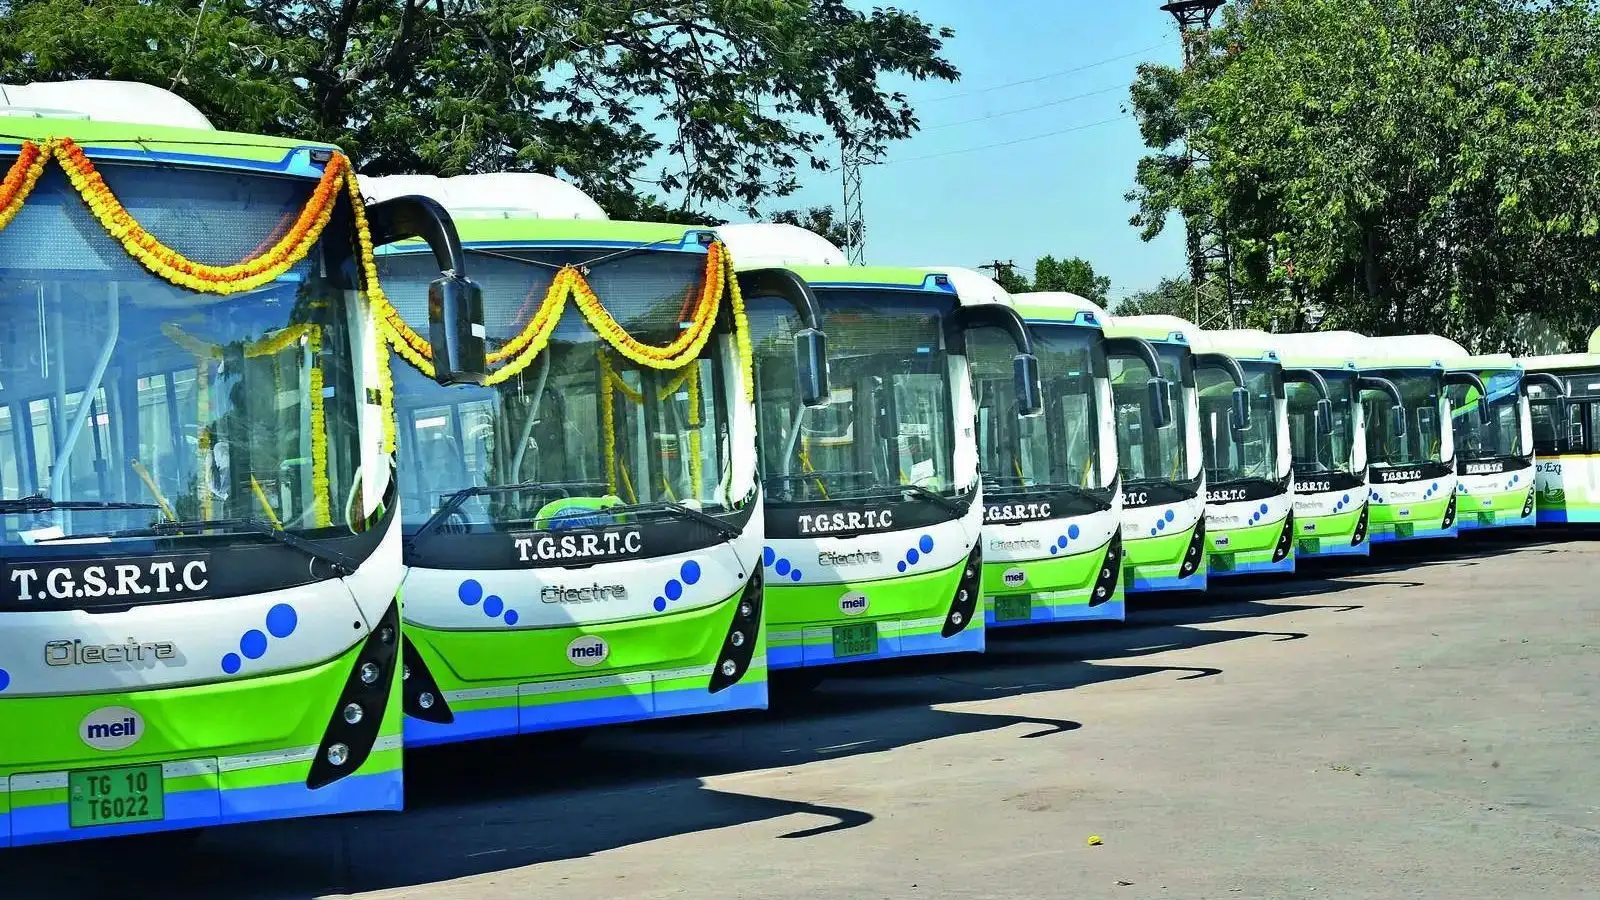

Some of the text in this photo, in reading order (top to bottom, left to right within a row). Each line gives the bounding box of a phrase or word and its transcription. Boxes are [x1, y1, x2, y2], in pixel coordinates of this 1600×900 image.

[798, 510, 893, 533] T.G.S.R.T.C
[514, 531, 641, 561] T.G.S.R.T.C
[10, 560, 208, 601] T.G.S.R.T.C
[1005, 572, 1024, 581] meil
[842, 597, 865, 609] meil
[571, 643, 603, 658] meil
[87, 717, 136, 739] meil
[87, 772, 148, 797] TG 10
[88, 795, 149, 820] T6022
